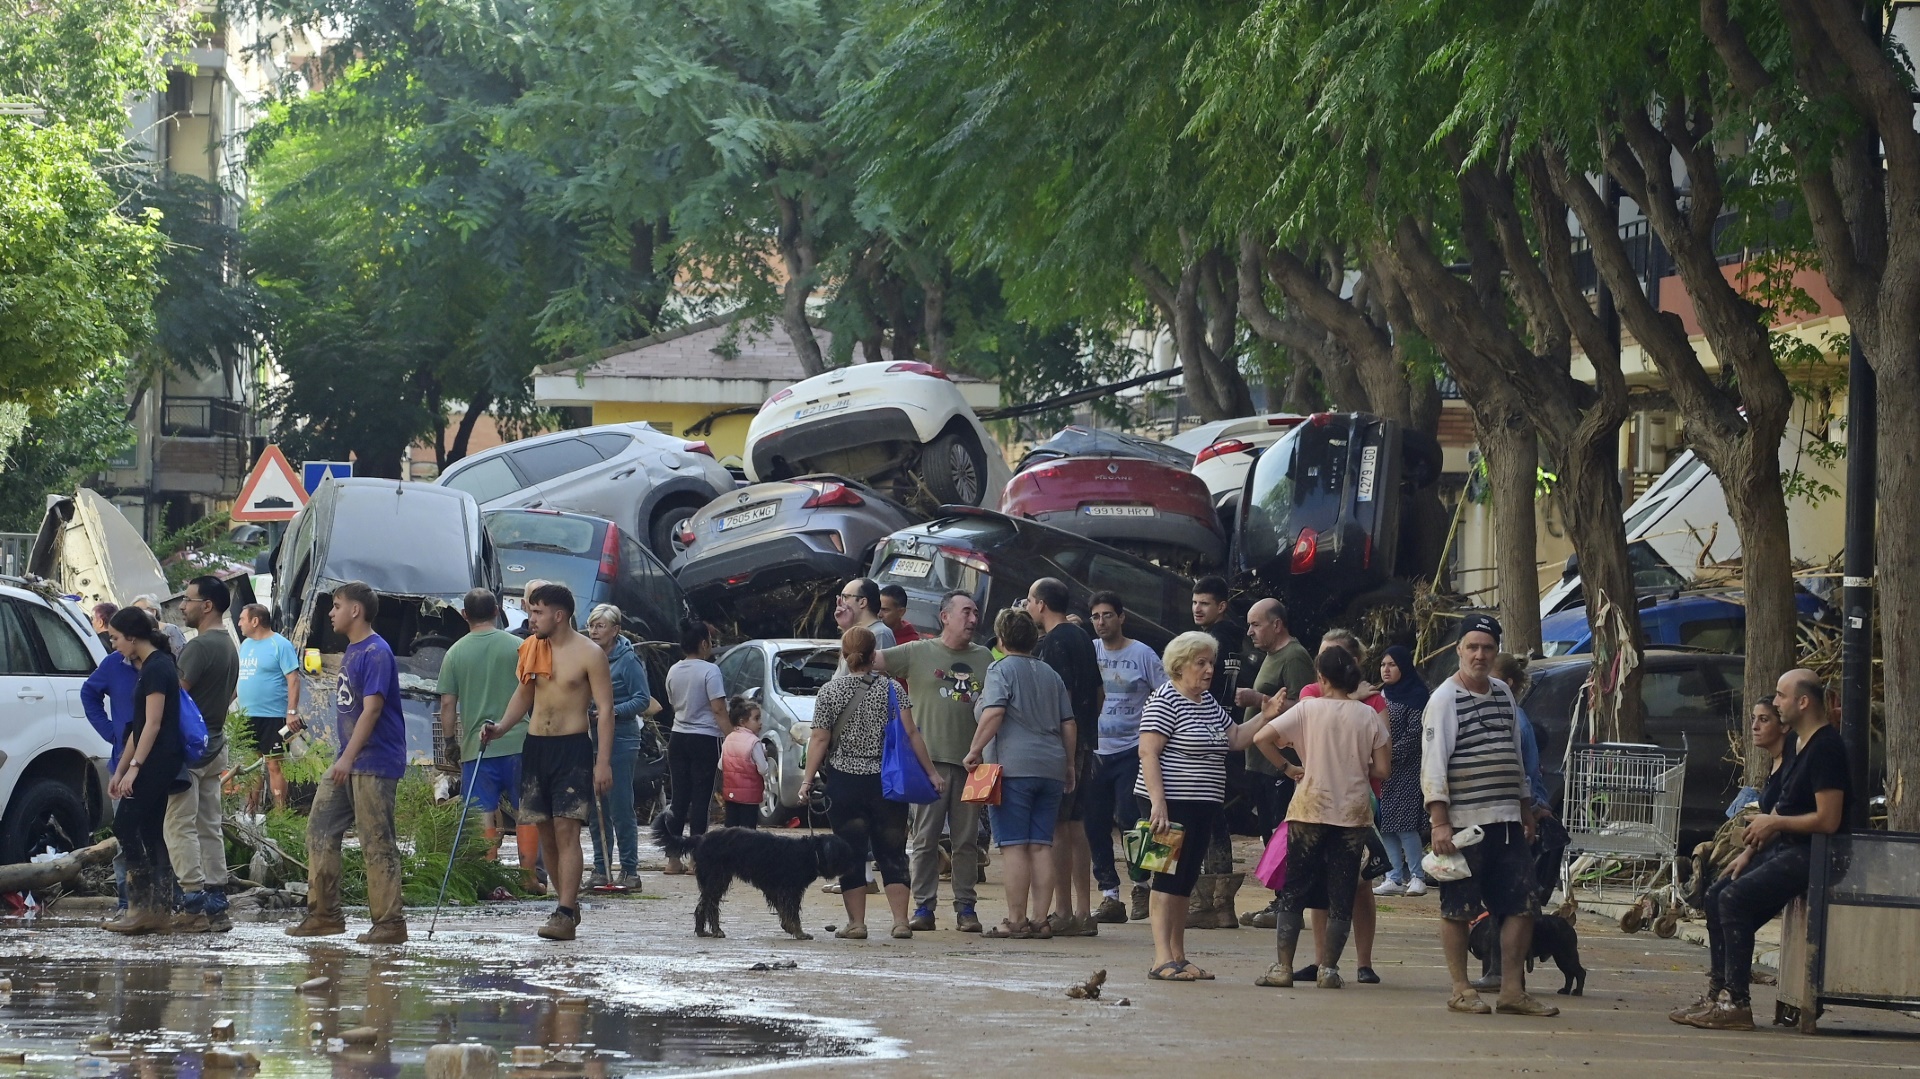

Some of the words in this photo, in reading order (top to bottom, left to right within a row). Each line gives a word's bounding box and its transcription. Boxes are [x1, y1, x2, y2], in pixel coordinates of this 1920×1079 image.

[1363, 449, 1376, 466] JGD
[1360, 470, 1373, 494] 4279
[727, 512, 750, 527] 7605
[752, 507, 772, 520] KMG
[1093, 507, 1123, 515] 9919
